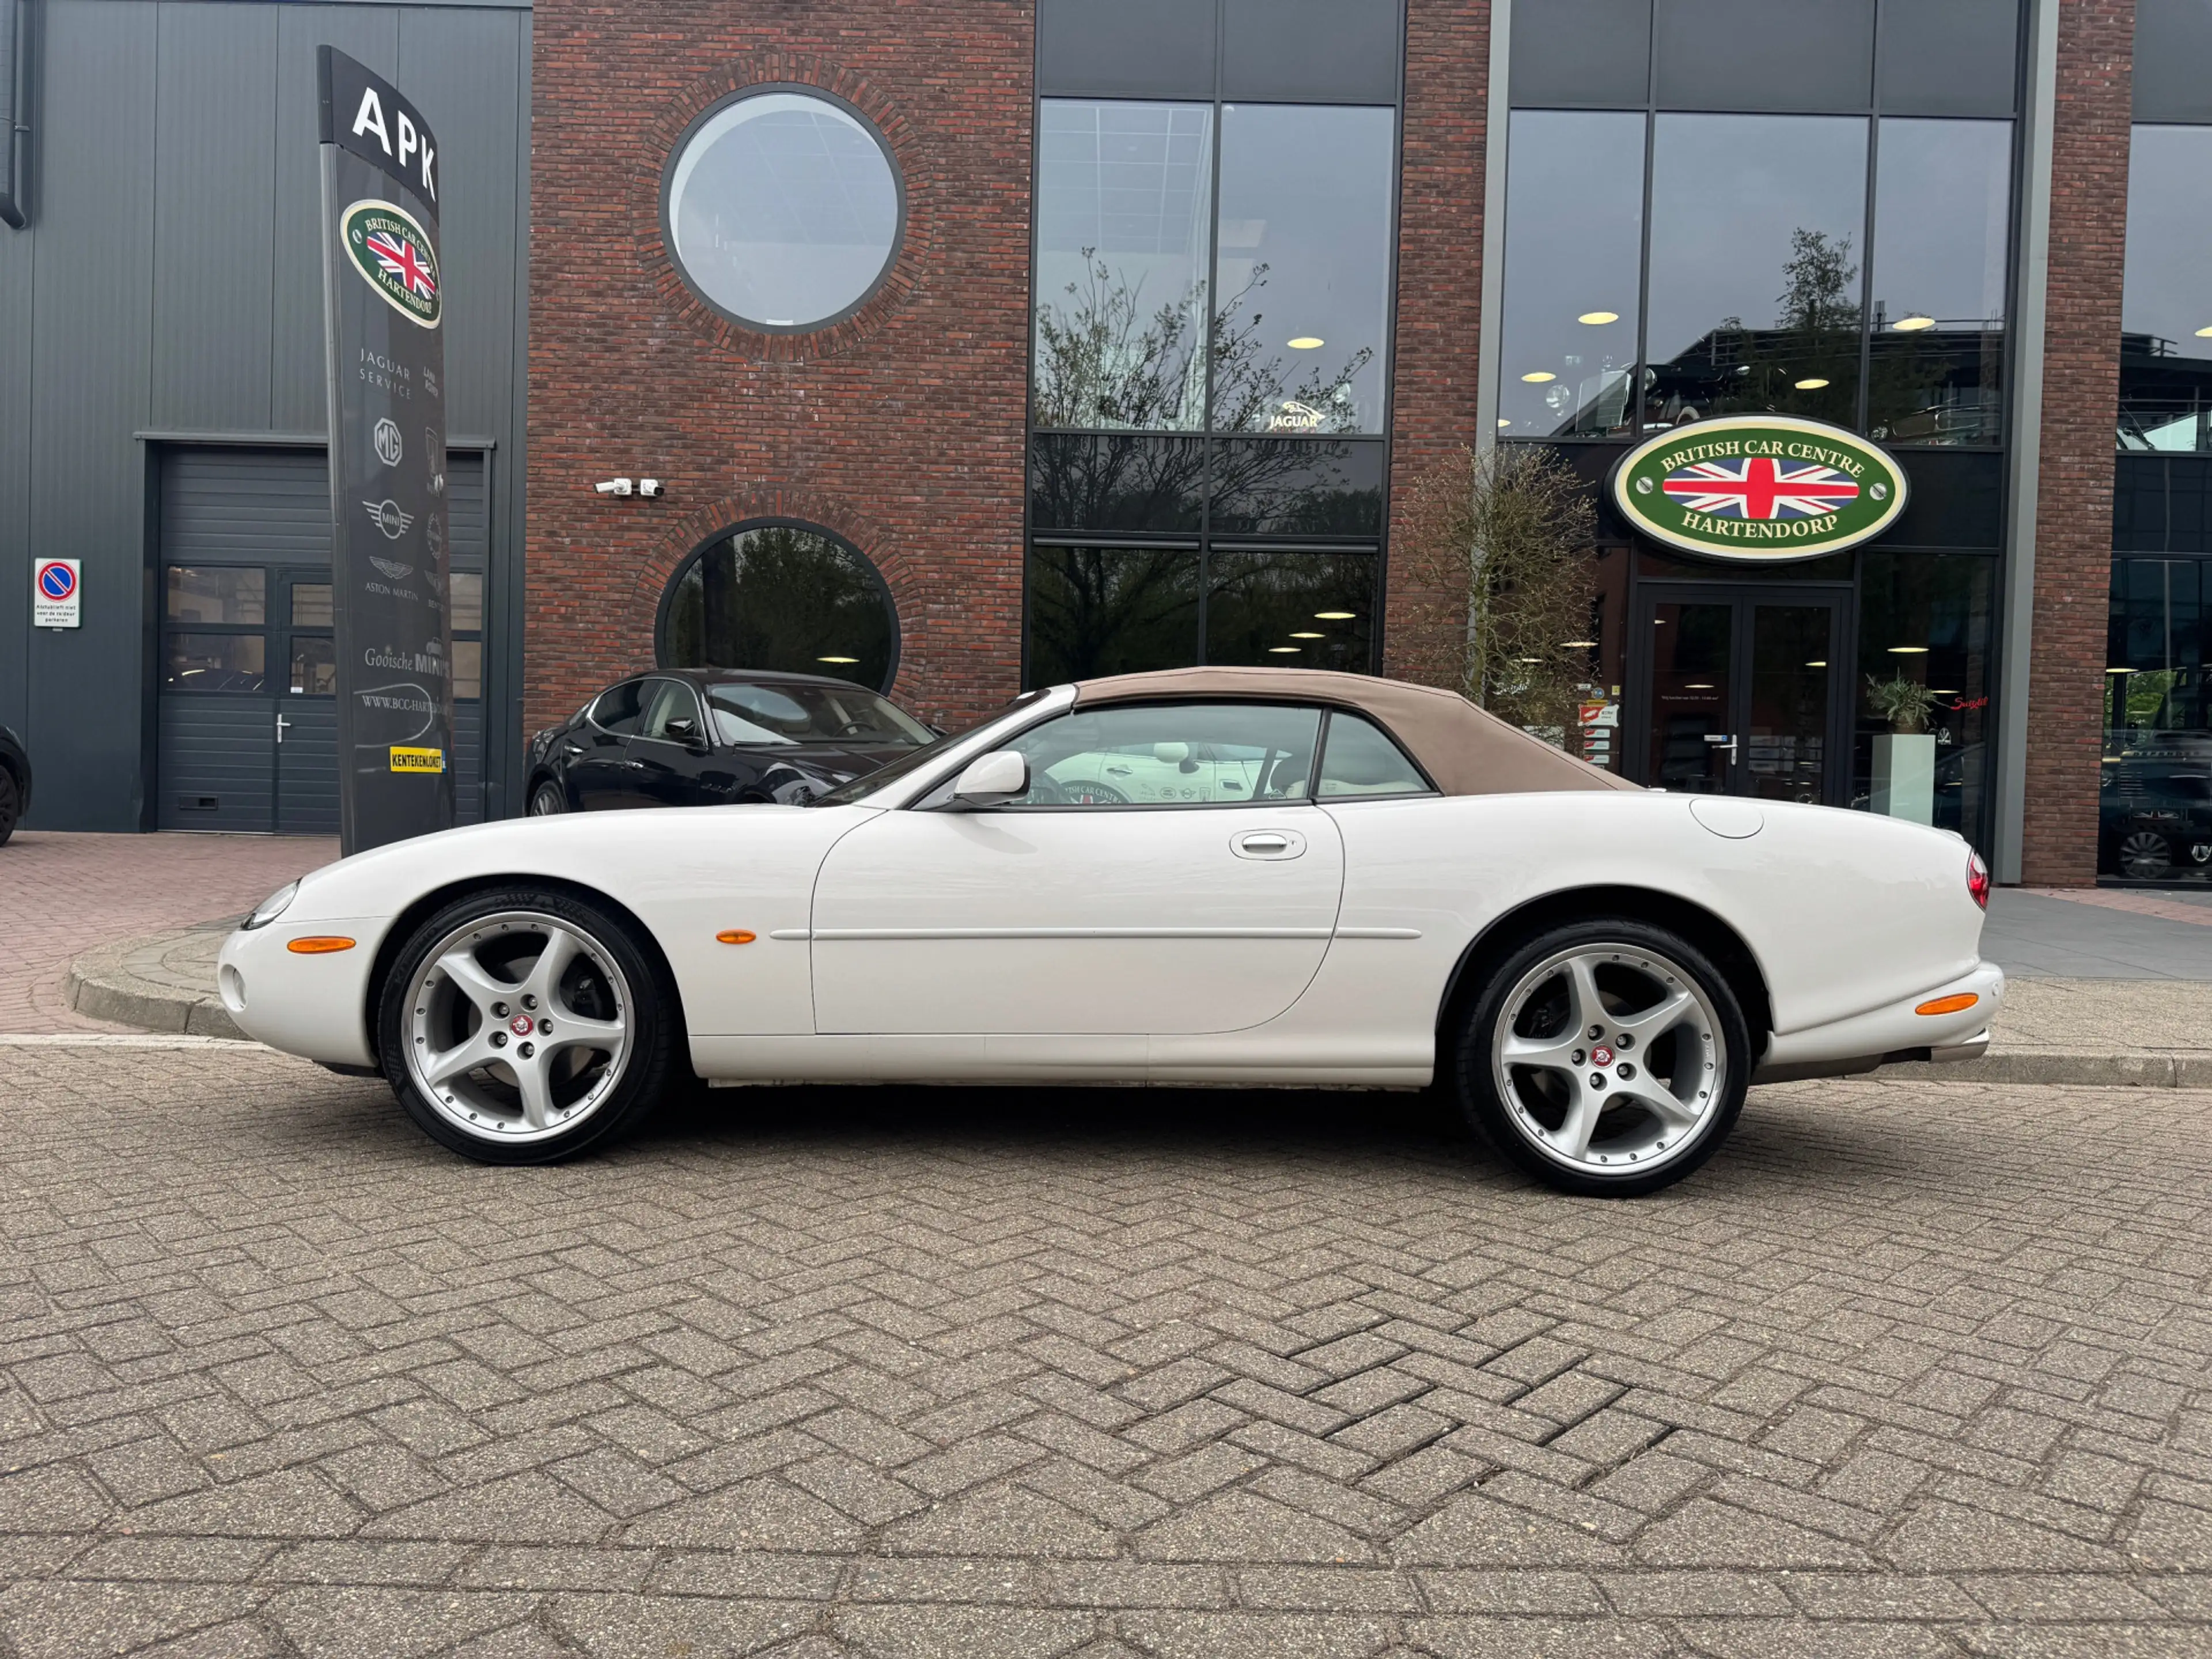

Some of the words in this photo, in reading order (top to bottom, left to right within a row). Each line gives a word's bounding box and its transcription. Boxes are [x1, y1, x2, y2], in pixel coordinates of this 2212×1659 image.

[353, 87, 436, 202] APK
[365, 218, 402, 235] BRITISH
[402, 227, 416, 246] CAR
[361, 348, 410, 381] JAGUAR
[359, 369, 411, 399] SERVICE
[1269, 415, 1318, 430] JAGUAR
[378, 425, 399, 460] MG
[1660, 441, 1740, 472] BRITISH
[1744, 440, 1785, 455] CAR
[1787, 442, 1865, 479] CENTRE
[382, 513, 400, 527] MINI
[1681, 511, 1838, 539] HARTENDORP
[365, 582, 391, 594] ASTON
[393, 588, 418, 600] MARTIN
[365, 647, 413, 671] Gooische
[392, 753, 441, 768] KENTEKENLOKET
[1081, 786, 1094, 795] CAR
